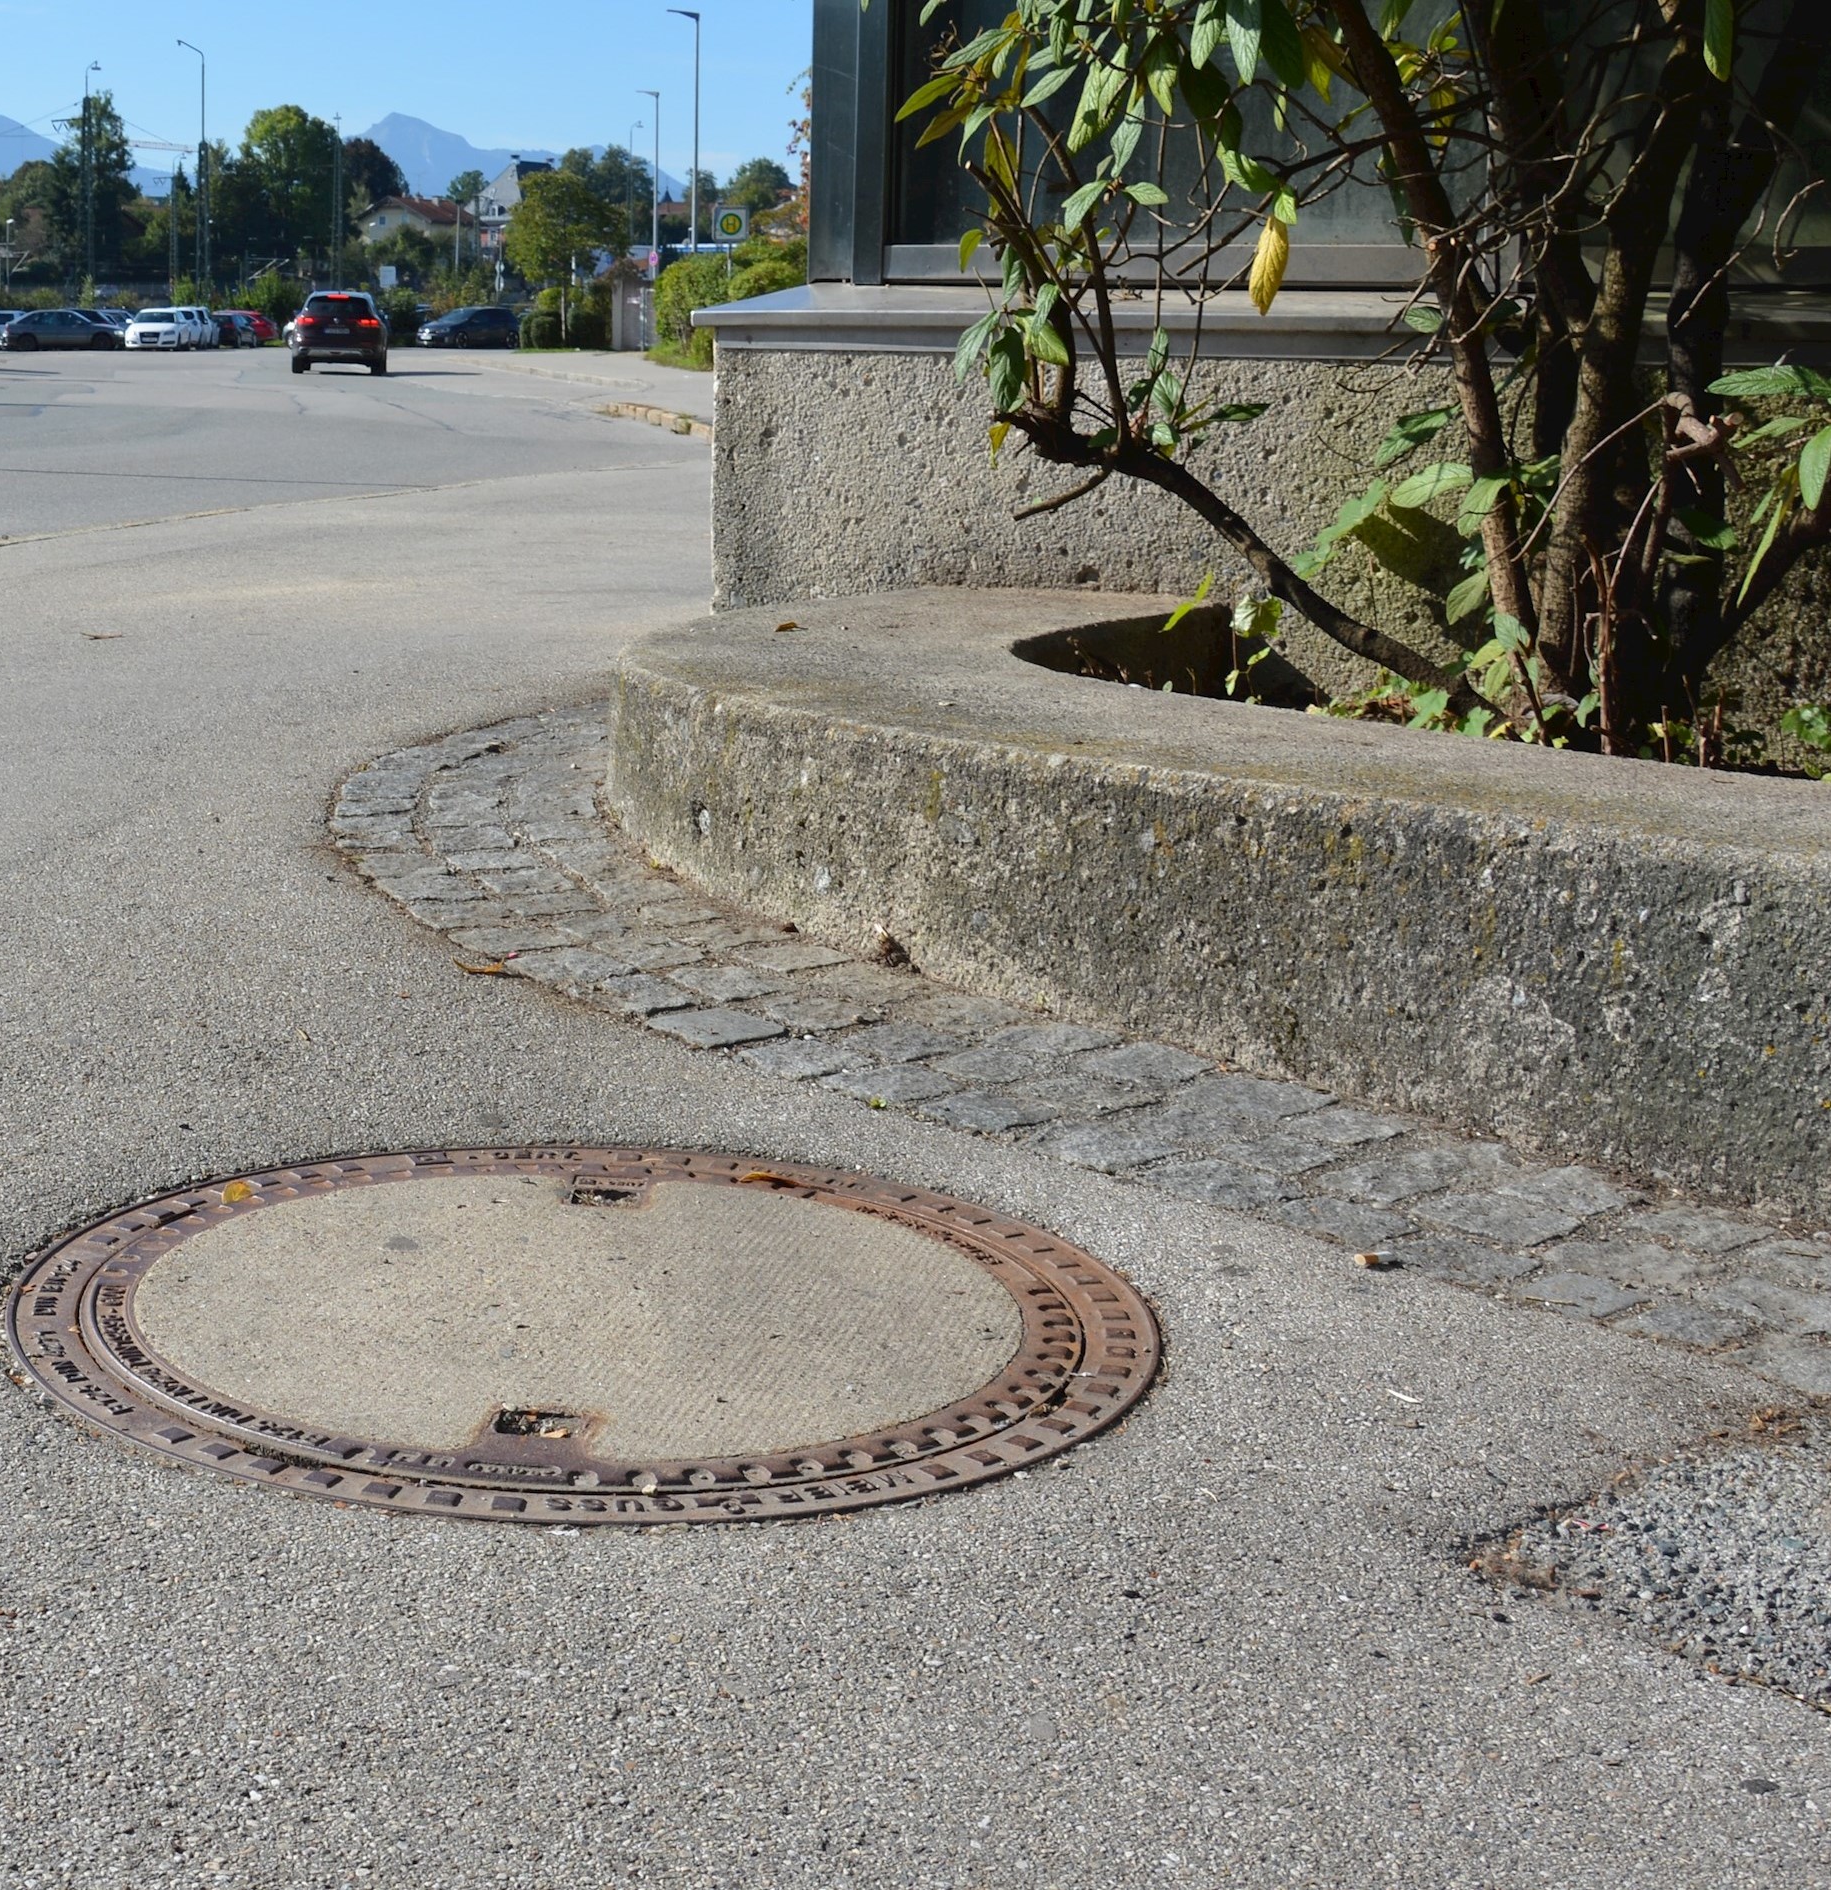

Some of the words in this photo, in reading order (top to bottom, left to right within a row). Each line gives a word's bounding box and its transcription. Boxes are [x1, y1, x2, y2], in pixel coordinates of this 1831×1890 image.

[32, 1296, 59, 1316] DIN
[34, 1330, 68, 1359] 4271
[51, 1359, 90, 1384] DIN
[199, 1401, 257, 1425] DIN
[774, 1470, 917, 1504] MEIER
[542, 1496, 685, 1513] GUSS
